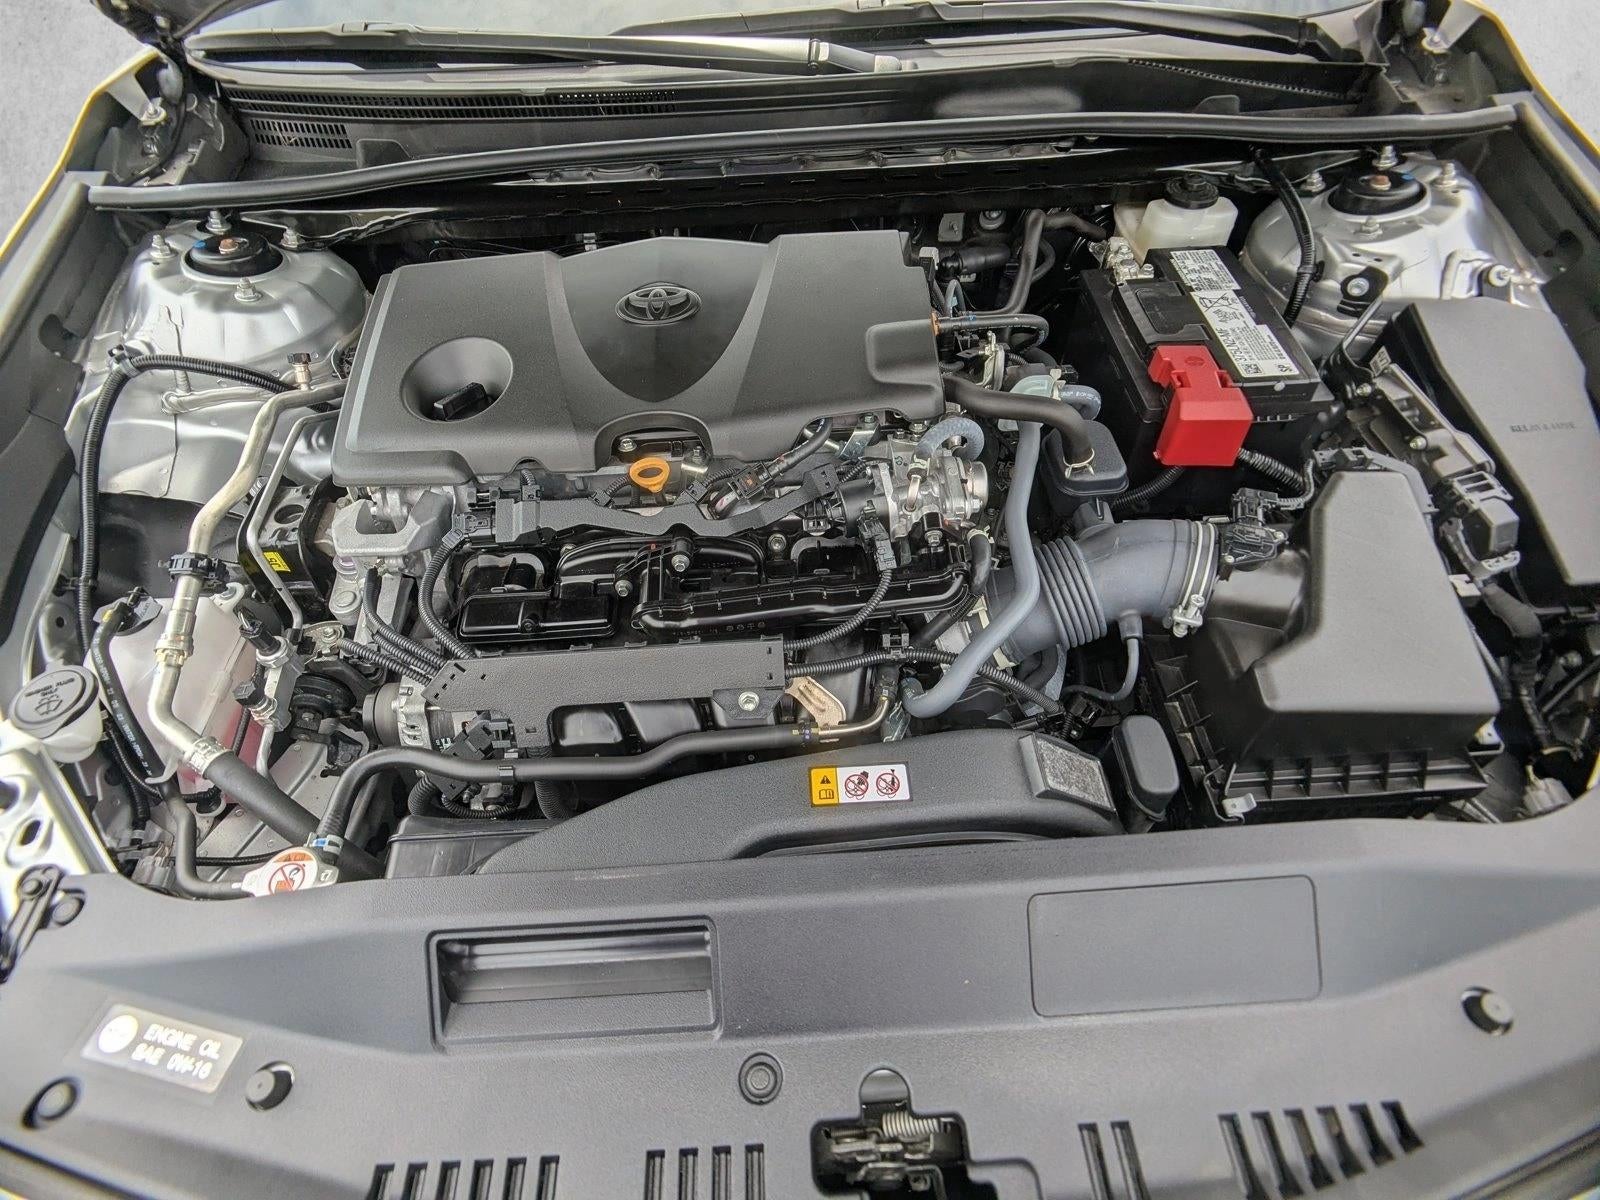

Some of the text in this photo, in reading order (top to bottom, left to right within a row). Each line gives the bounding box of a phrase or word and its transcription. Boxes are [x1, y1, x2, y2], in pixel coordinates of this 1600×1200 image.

[131, 1043, 165, 1066] SAE
[143, 1023, 222, 1060] ENGINE OIL
